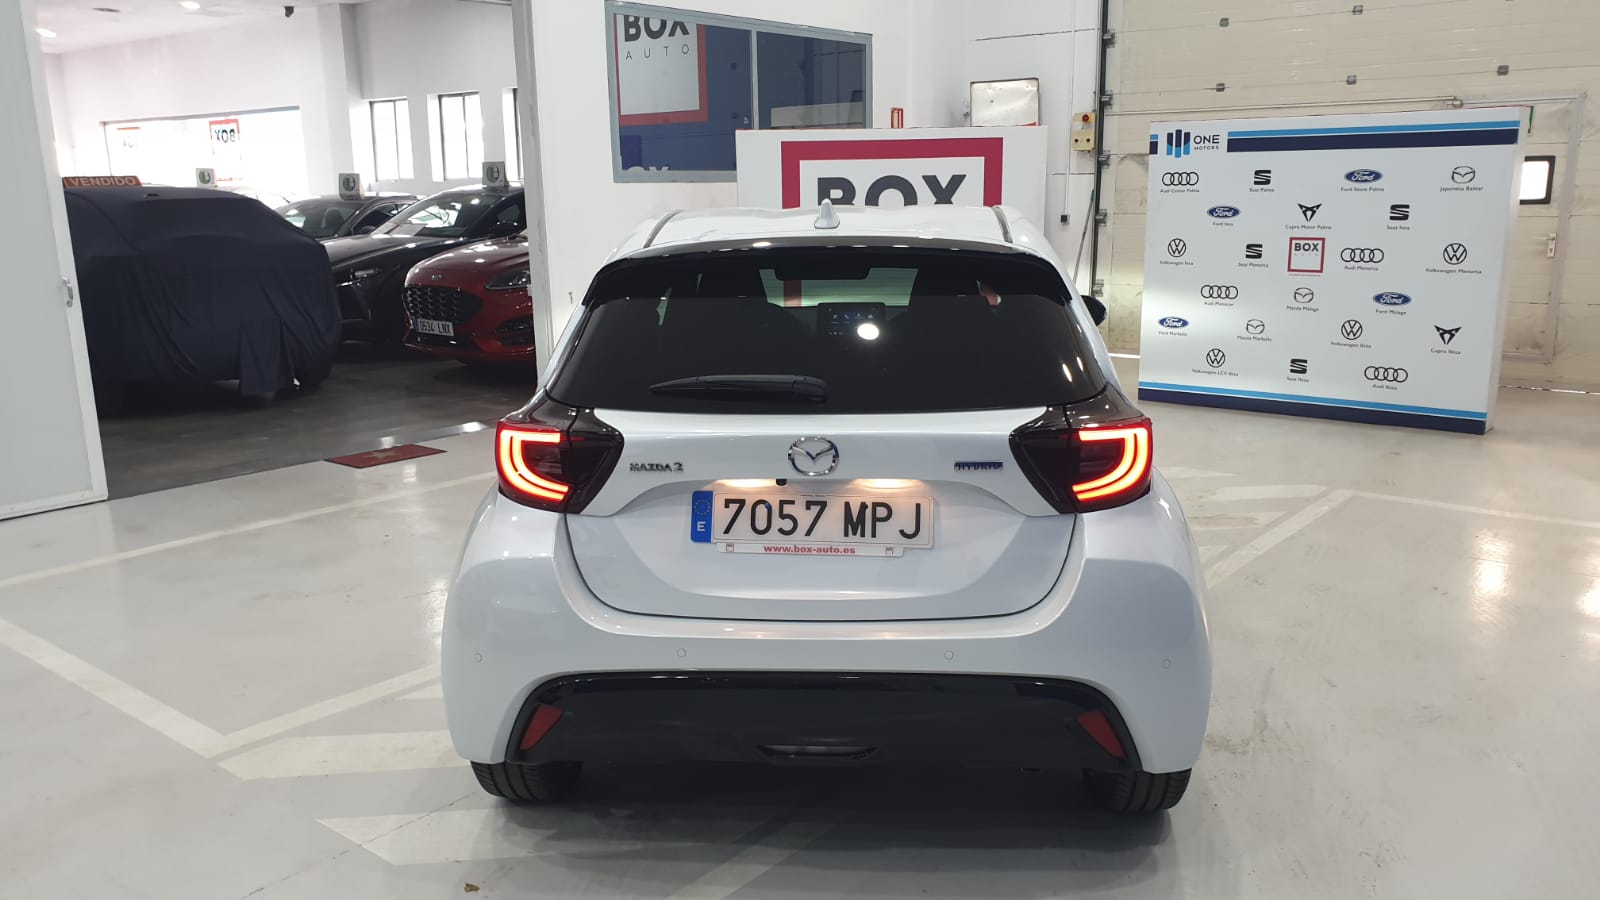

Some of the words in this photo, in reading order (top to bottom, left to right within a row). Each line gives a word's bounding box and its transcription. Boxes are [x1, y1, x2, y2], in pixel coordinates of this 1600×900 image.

[625, 44, 691, 60] AUTO
[1193, 134, 1220, 145] ONE
[69, 176, 137, 187] VENDIDO
[1294, 242, 1320, 252] BOX
[722, 498, 828, 537] 7057
[843, 501, 922, 540] MPJ
[696, 521, 706, 532] E
[763, 543, 856, 555] www.box-auto.es
